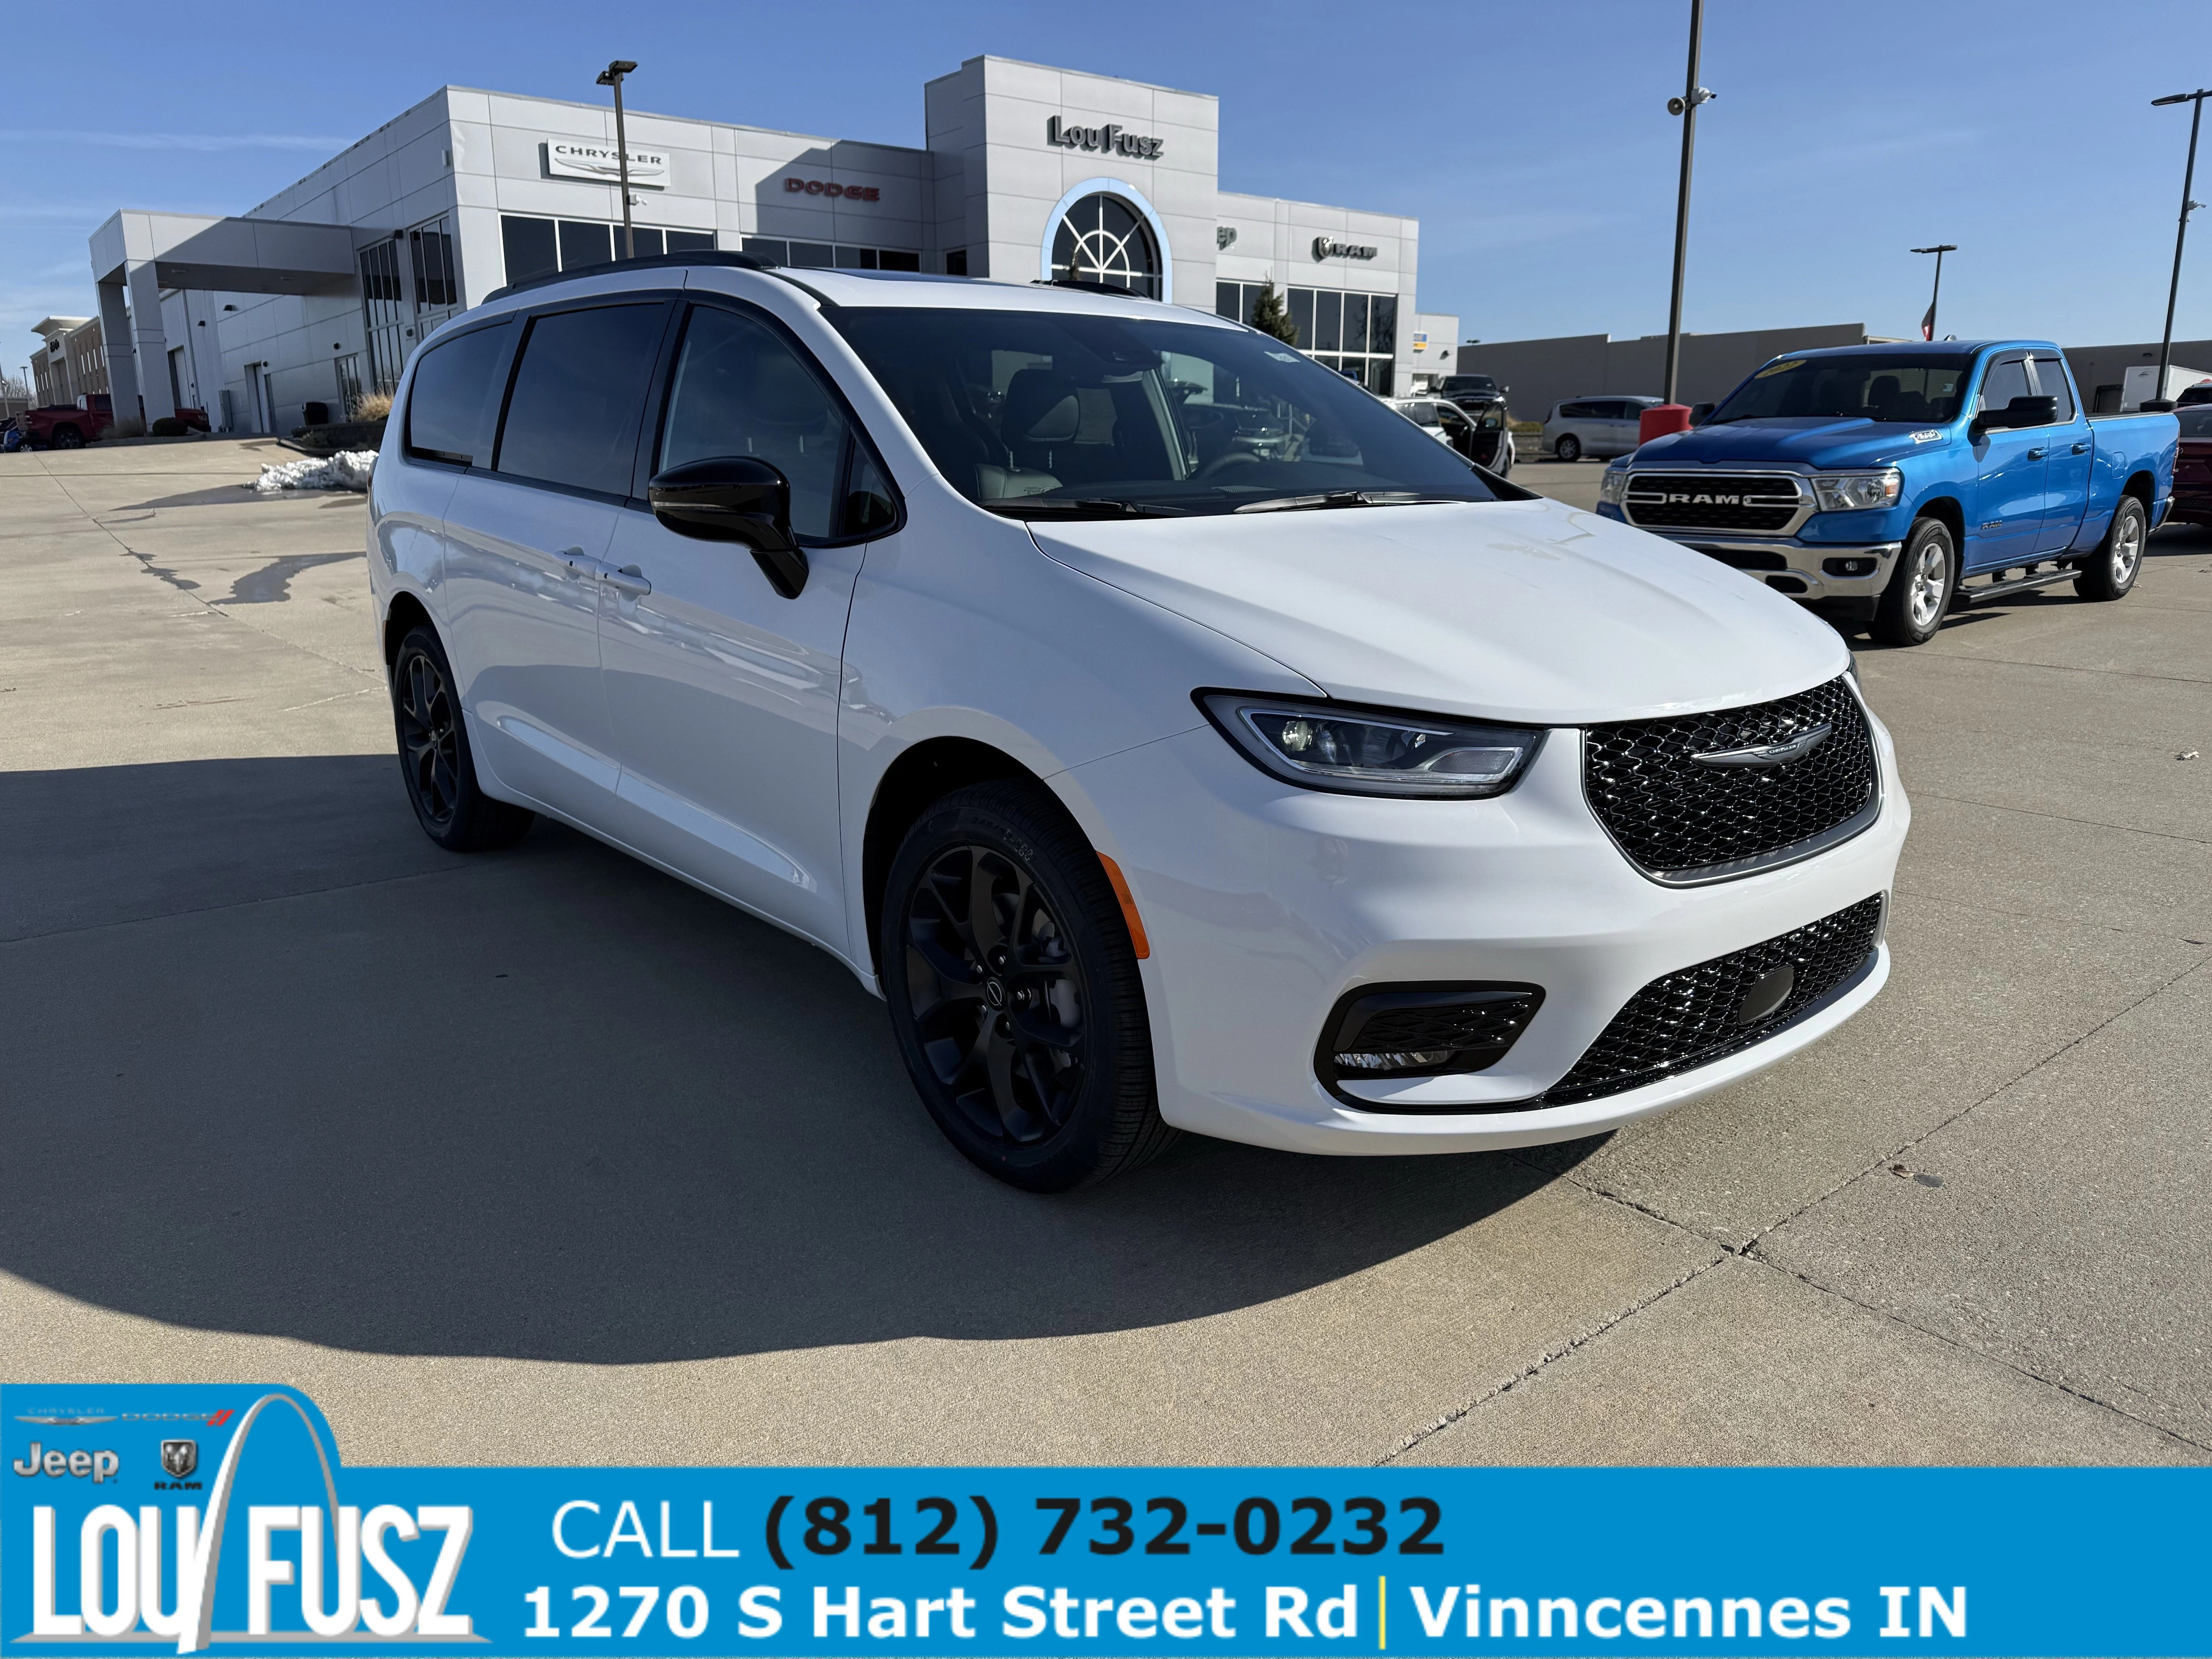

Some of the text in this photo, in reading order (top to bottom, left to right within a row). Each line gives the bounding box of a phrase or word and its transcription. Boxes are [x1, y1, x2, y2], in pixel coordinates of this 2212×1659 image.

[1051, 115, 1164, 156] Lou Fusz
[555, 145, 662, 165] CHRYSLER
[786, 177, 880, 201] DODGE
[1217, 226, 1237, 250] ep
[1334, 243, 1377, 258] RAM
[1669, 493, 1740, 504] RAM
